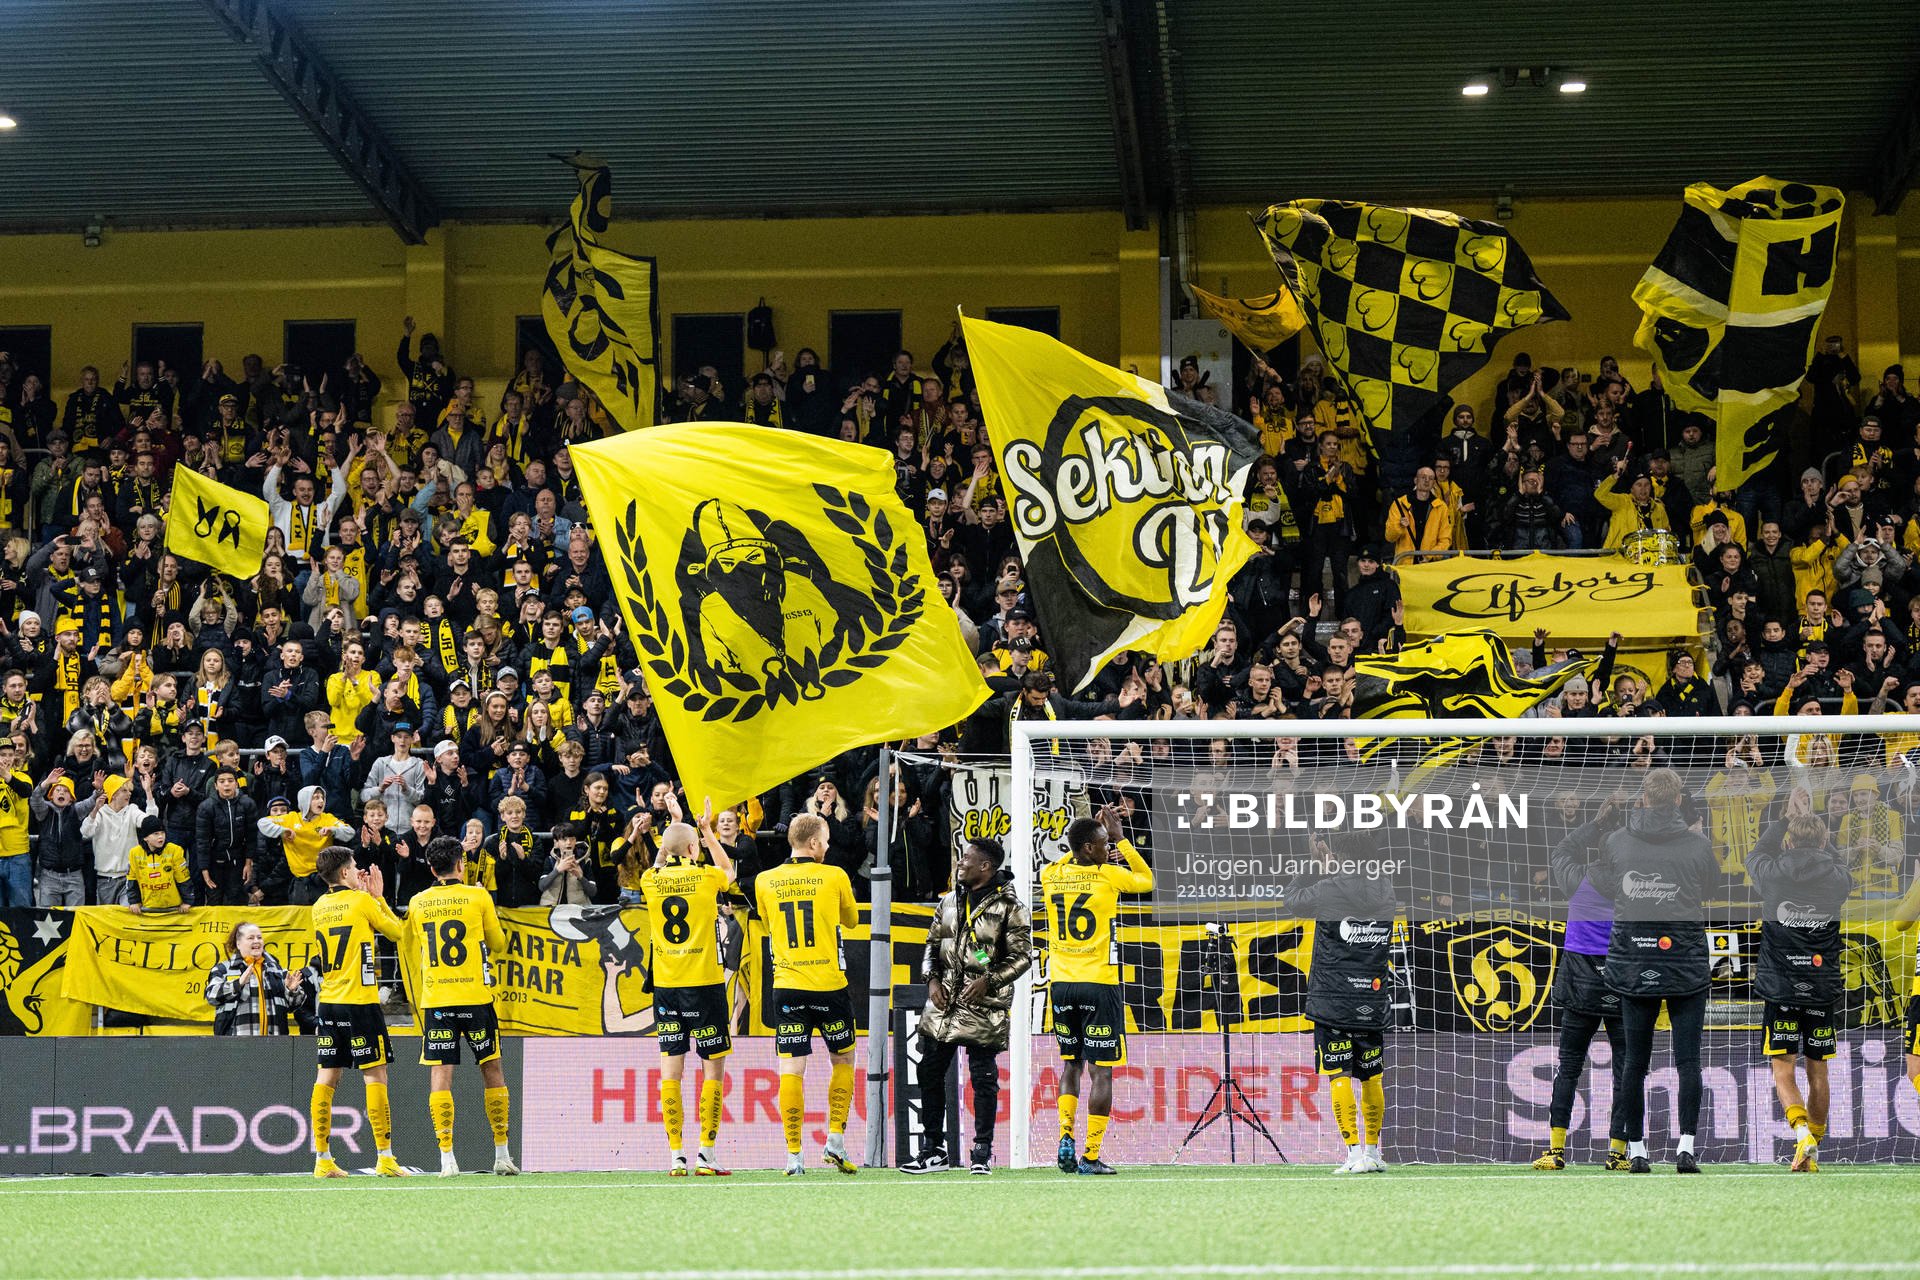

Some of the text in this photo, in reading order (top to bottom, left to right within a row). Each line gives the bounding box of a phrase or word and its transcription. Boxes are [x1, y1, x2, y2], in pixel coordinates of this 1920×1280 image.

[1432, 571, 1664, 622] Elfsborg
[964, 806, 1070, 842] Elfsrg
[769, 877, 823, 889] Sparbanken
[775, 888, 816, 899] Sjuhärad
[418, 897, 469, 908] Sparbanken
[424, 908, 463, 919] Sjuhärad
[1050, 893, 1096, 940] 16
[661, 895, 690, 944] 8
[778, 900, 815, 949] 11
[1420, 908, 1567, 935] ELFSBORG
[200, 921, 230, 933] THE
[422, 920, 467, 967] 18
[502, 991, 527, 1003] 2013
[658, 1023, 679, 1032] EAB
[780, 1024, 802, 1034] EAB
[1776, 1021, 1798, 1031] EAB
[430, 1031, 452, 1040] EAB
[693, 1027, 715, 1038] EAB
[1088, 1027, 1111, 1037] EAB
[657, 1034, 684, 1043] ernera
[1084, 1038, 1118, 1048] Cernera
